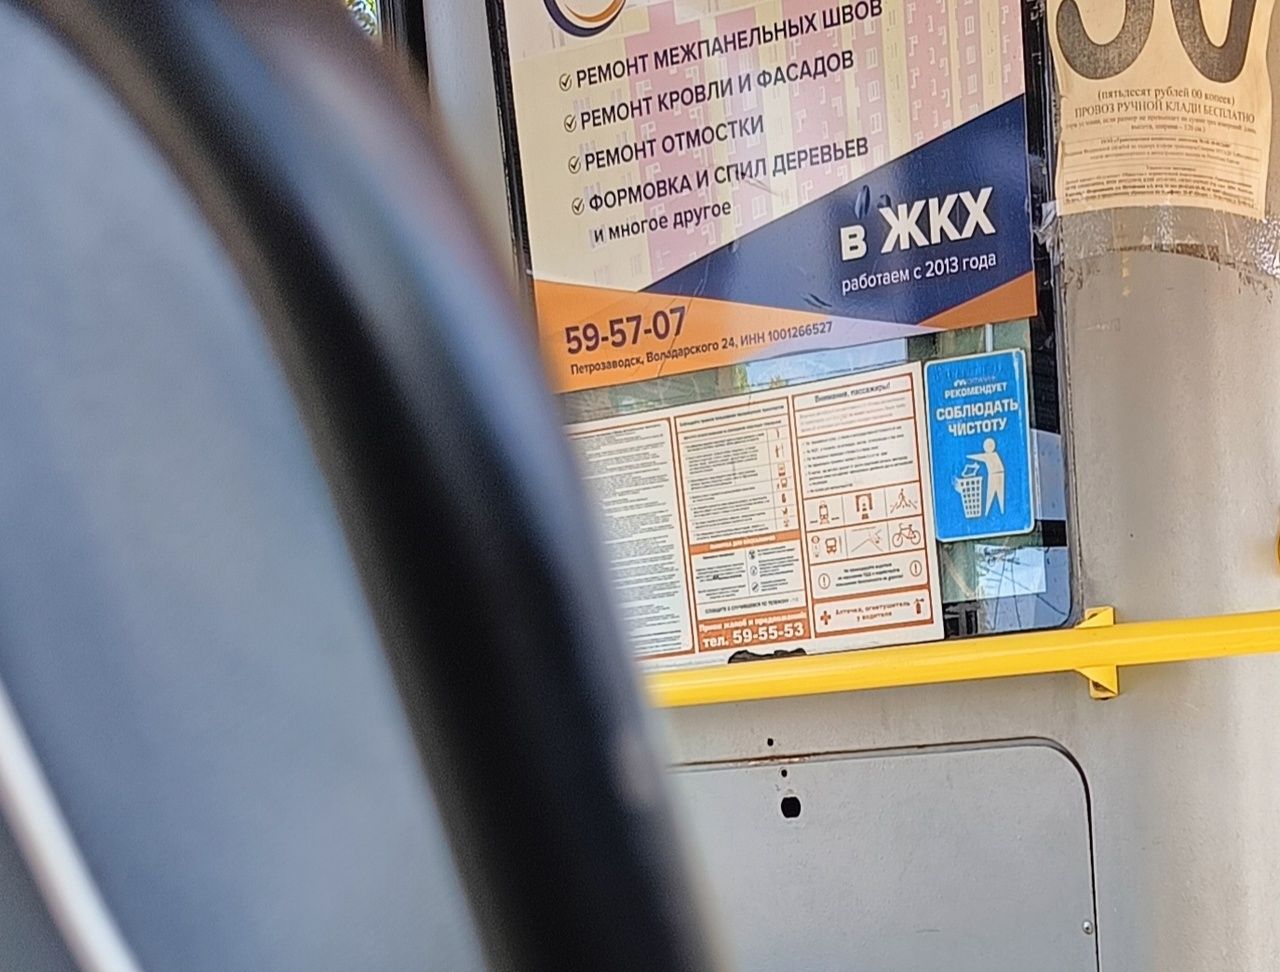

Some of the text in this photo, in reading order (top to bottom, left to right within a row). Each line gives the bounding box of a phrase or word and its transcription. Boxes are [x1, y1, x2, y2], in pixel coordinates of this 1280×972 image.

[576, 0, 883, 88] РЕМОНТ МЕЖПАНЕЛЬНЫХ ШВОВ
[581, 50, 855, 129] РЕМОНТ КРОВЛИ И ФАСАДОВ
[1154, 86, 1189, 99] рублей
[1191, 89, 1203, 99] 00
[1075, 100, 1255, 124] ПРОВОЗ РУЧНОЙ КЛАДИ БЕСПЛАТНО
[584, 114, 765, 171] РЕМОНТ ОТМОСТКИ
[589, 136, 869, 212] ФОРМОВКА И СПИЛ ДЕРЕВЬЕВ
[594, 201, 731, 243] и многое другое
[878, 187, 997, 254] ЖКХ
[842, 253, 997, 296] работаем с 2013 года
[565, 305, 686, 355] 59-57-07
[570, 355, 645, 375] Петрозаводск,
[721, 337, 739, 350] 24,
[740, 333, 766, 346] ИНН
[768, 321, 833, 342] 1001266527
[936, 398, 1019, 421] СОБЛЮДАТЬ
[944, 382, 1008, 399] РЕКОМЕНДУЕТ
[948, 417, 1007, 437] ЧИСТОТУ
[703, 622, 804, 648] тел. 59-55-53
